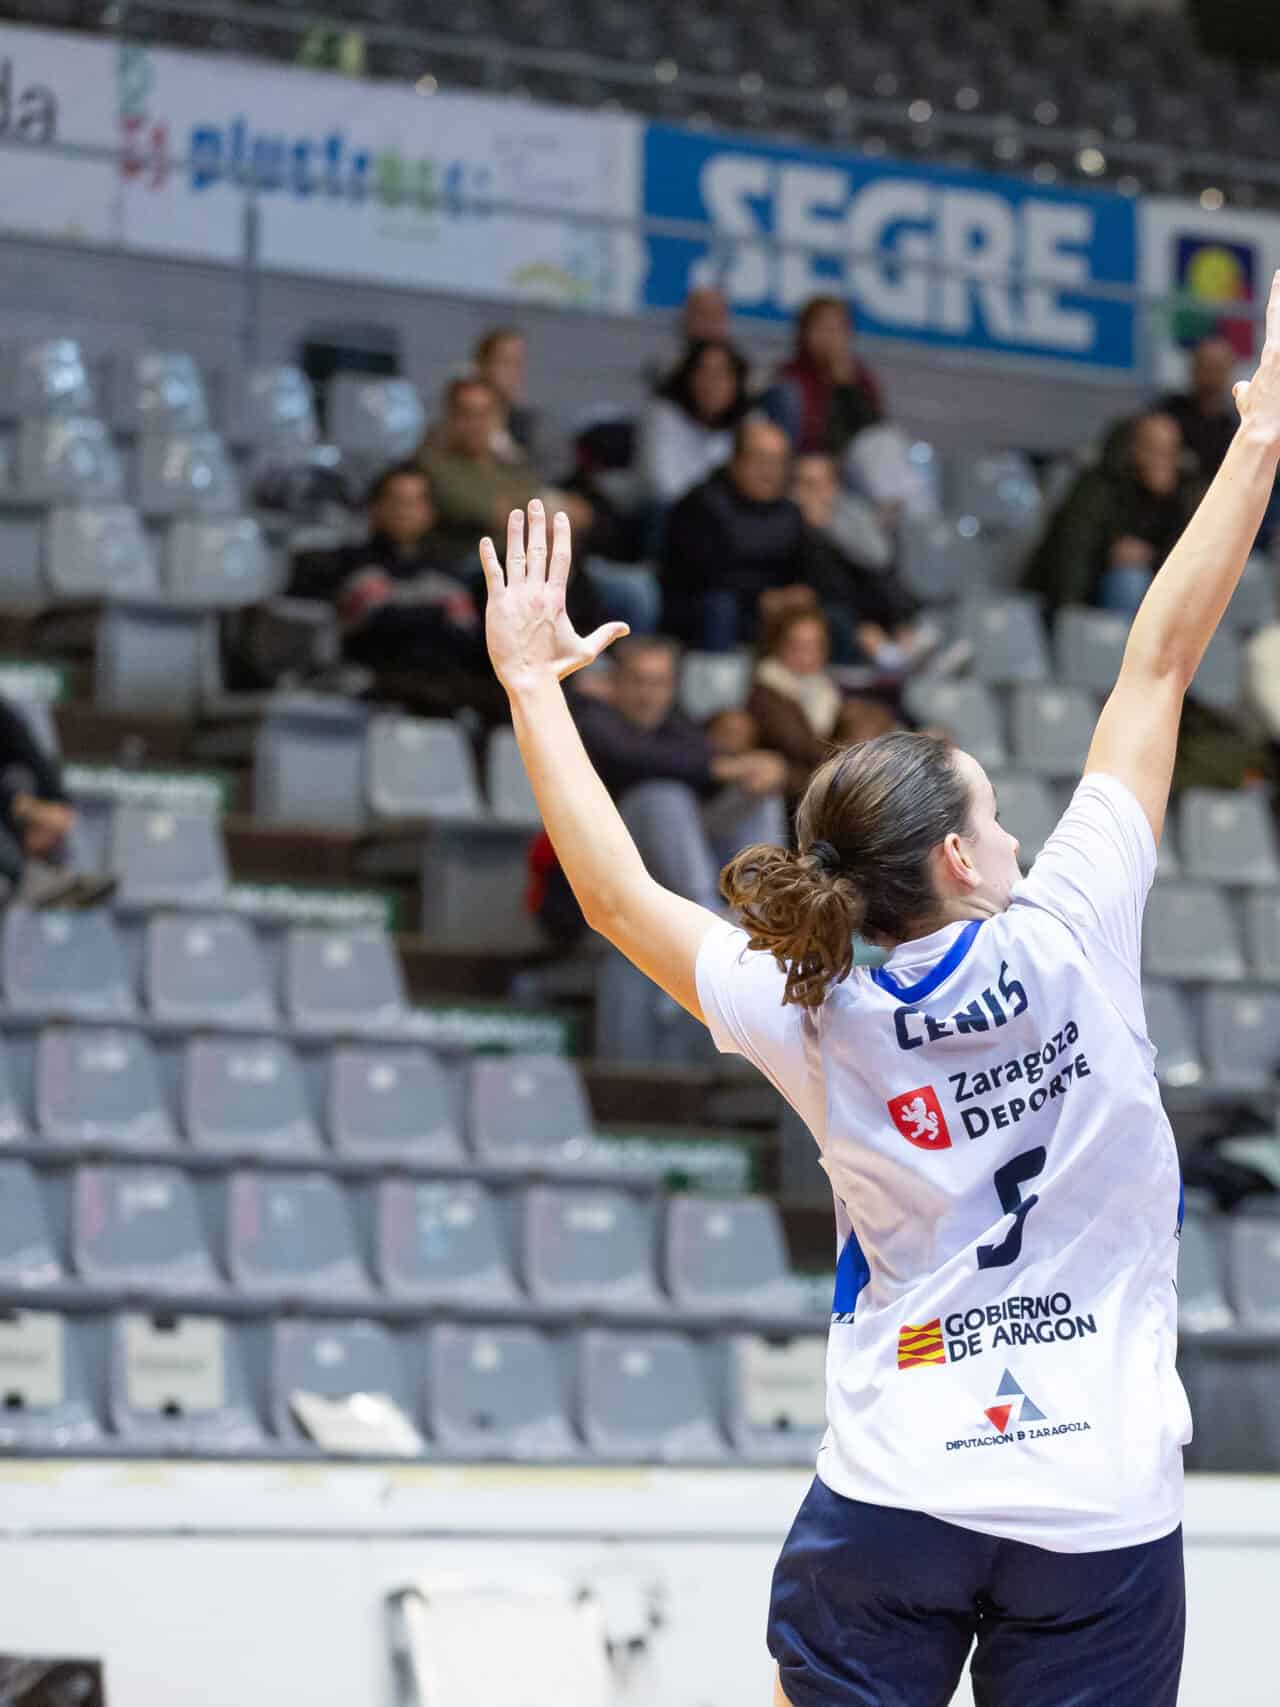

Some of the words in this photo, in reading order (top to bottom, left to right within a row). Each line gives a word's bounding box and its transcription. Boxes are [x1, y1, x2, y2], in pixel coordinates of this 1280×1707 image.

[688, 153, 1097, 349] SEGRE
[948, 1020, 1079, 1103] Zaragoza
[961, 1053, 1091, 1140] DEPORTE
[977, 1145, 1047, 1271] 5
[945, 1292, 1071, 1337] GOBIERNO
[948, 1332, 982, 1362] DE
[992, 1314, 1097, 1348] ARAGON
[946, 1433, 1014, 1451] DIPUTACION
[1030, 1421, 1091, 1438] ZARAGOZA
